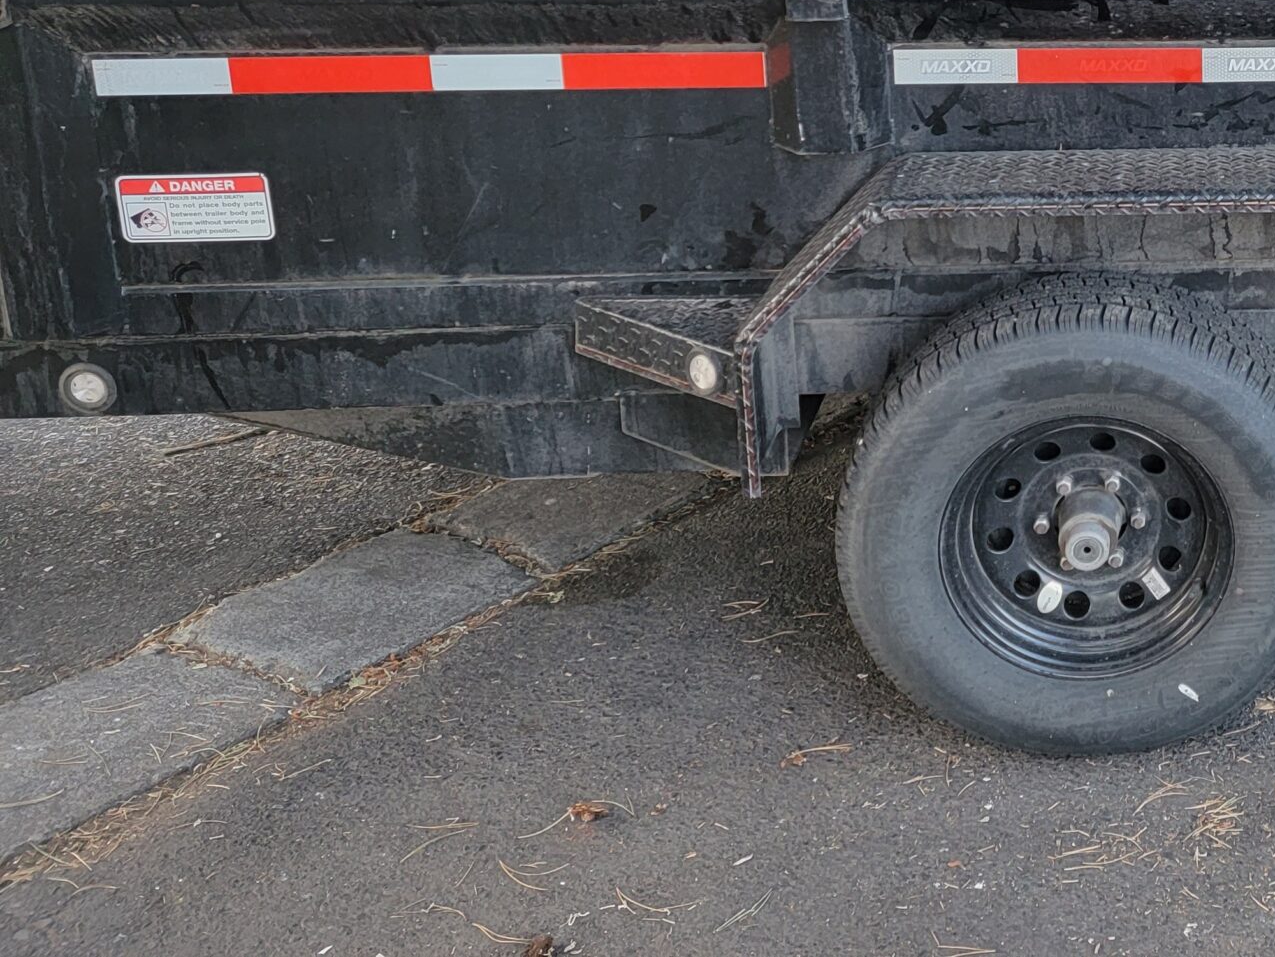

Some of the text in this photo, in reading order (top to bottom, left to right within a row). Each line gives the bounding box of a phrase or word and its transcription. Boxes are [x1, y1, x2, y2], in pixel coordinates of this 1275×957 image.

[169, 180, 235, 192] DANGER
[198, 202, 219, 210] place
[222, 201, 241, 209] body
[244, 201, 263, 209] parts
[182, 228, 207, 237] upright
